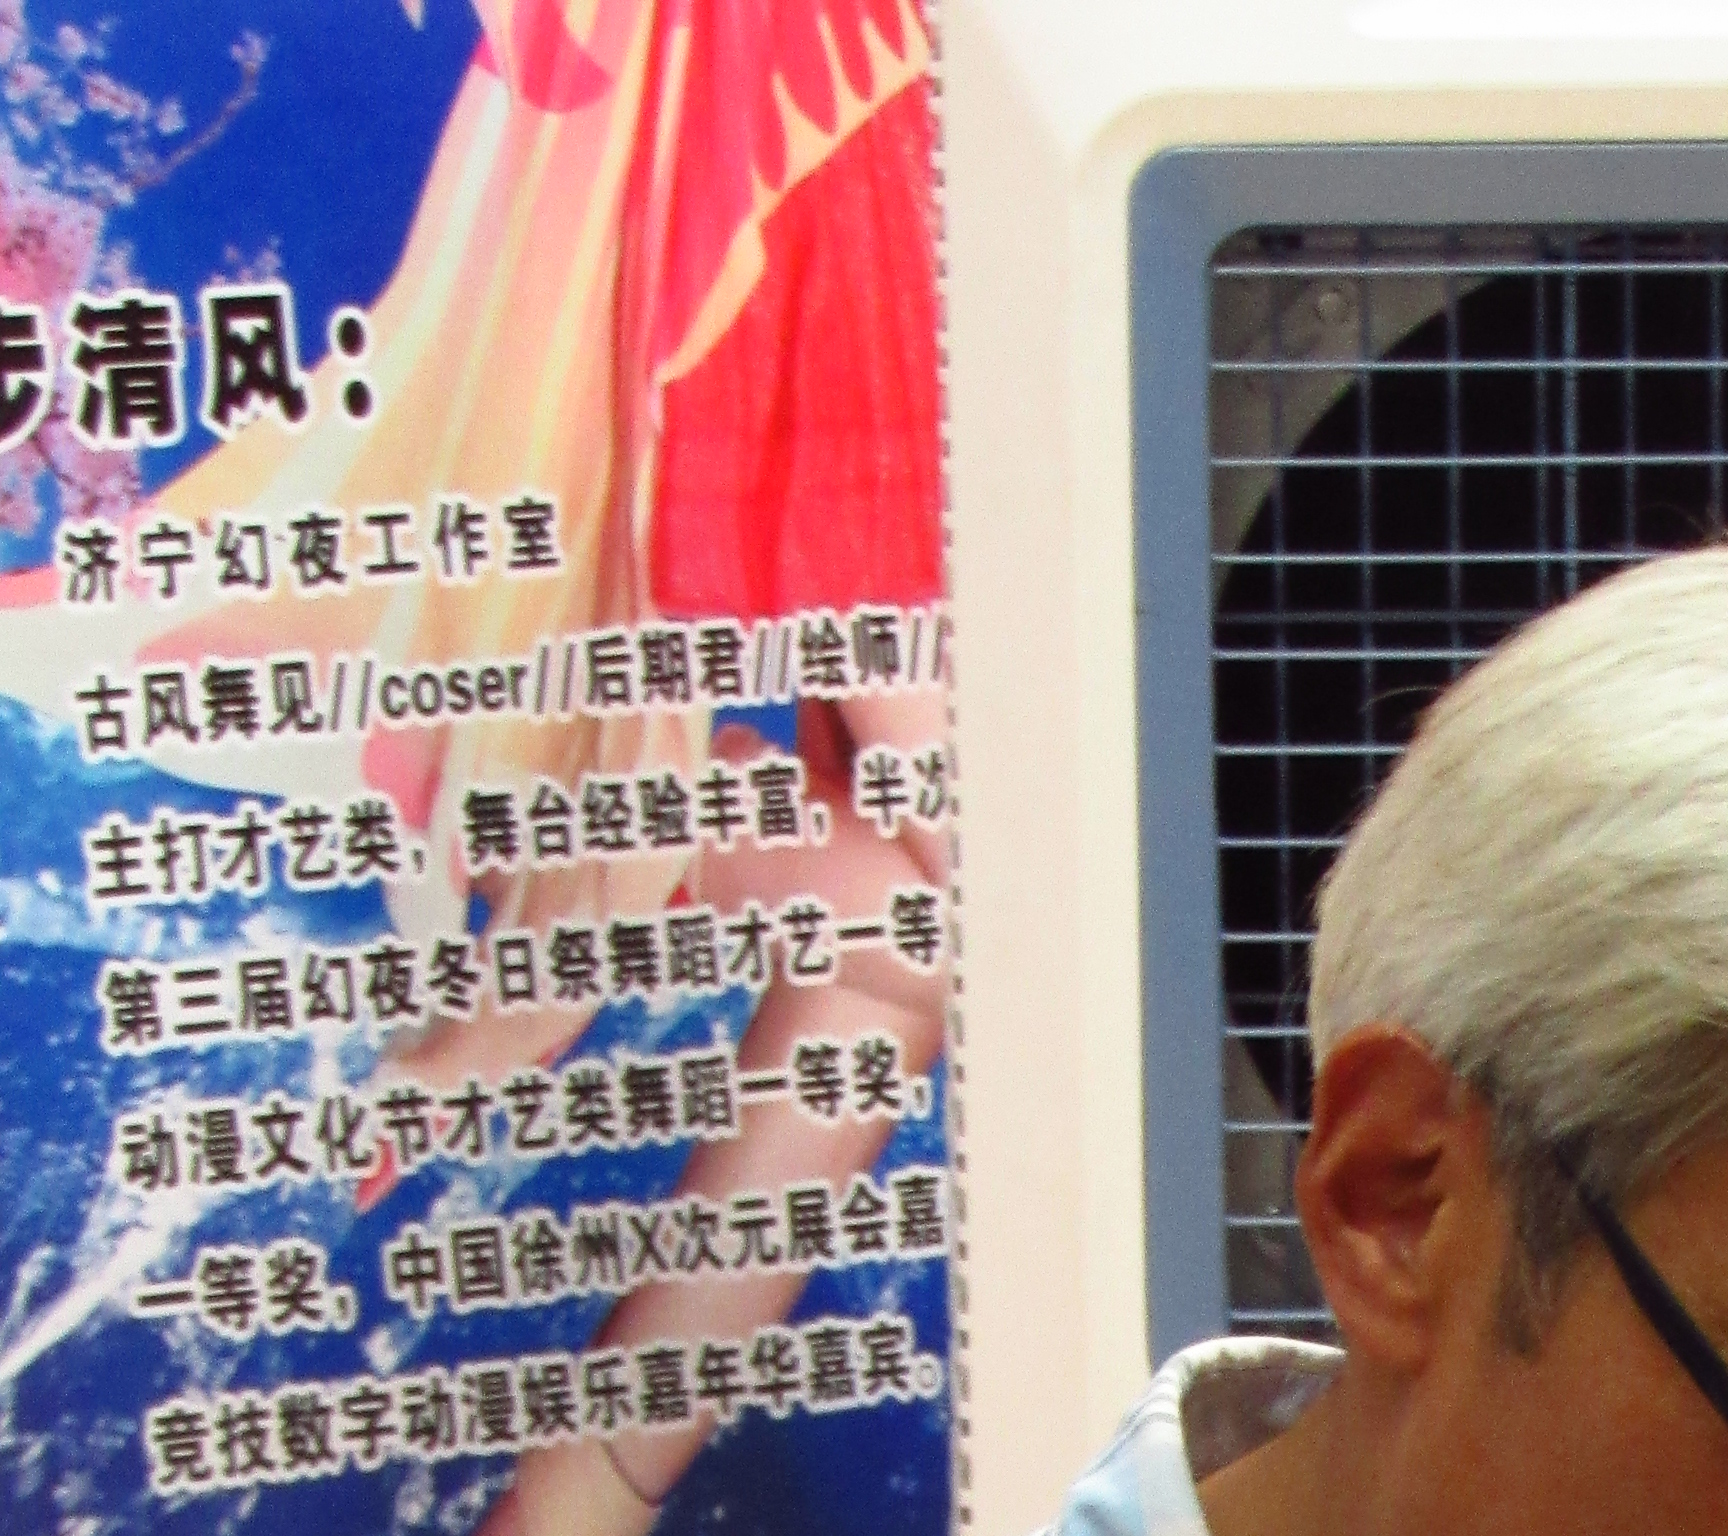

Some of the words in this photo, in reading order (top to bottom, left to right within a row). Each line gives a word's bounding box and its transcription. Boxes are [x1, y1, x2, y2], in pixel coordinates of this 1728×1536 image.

[63, 497, 559, 602] 济宁幻夜工作室
[104, 891, 941, 1045] 第三届幻夜冬日祭舞蹈才艺一等
[153, 1321, 939, 1484] 竞技数字动漫娱乐嘉年华嘉宾。
